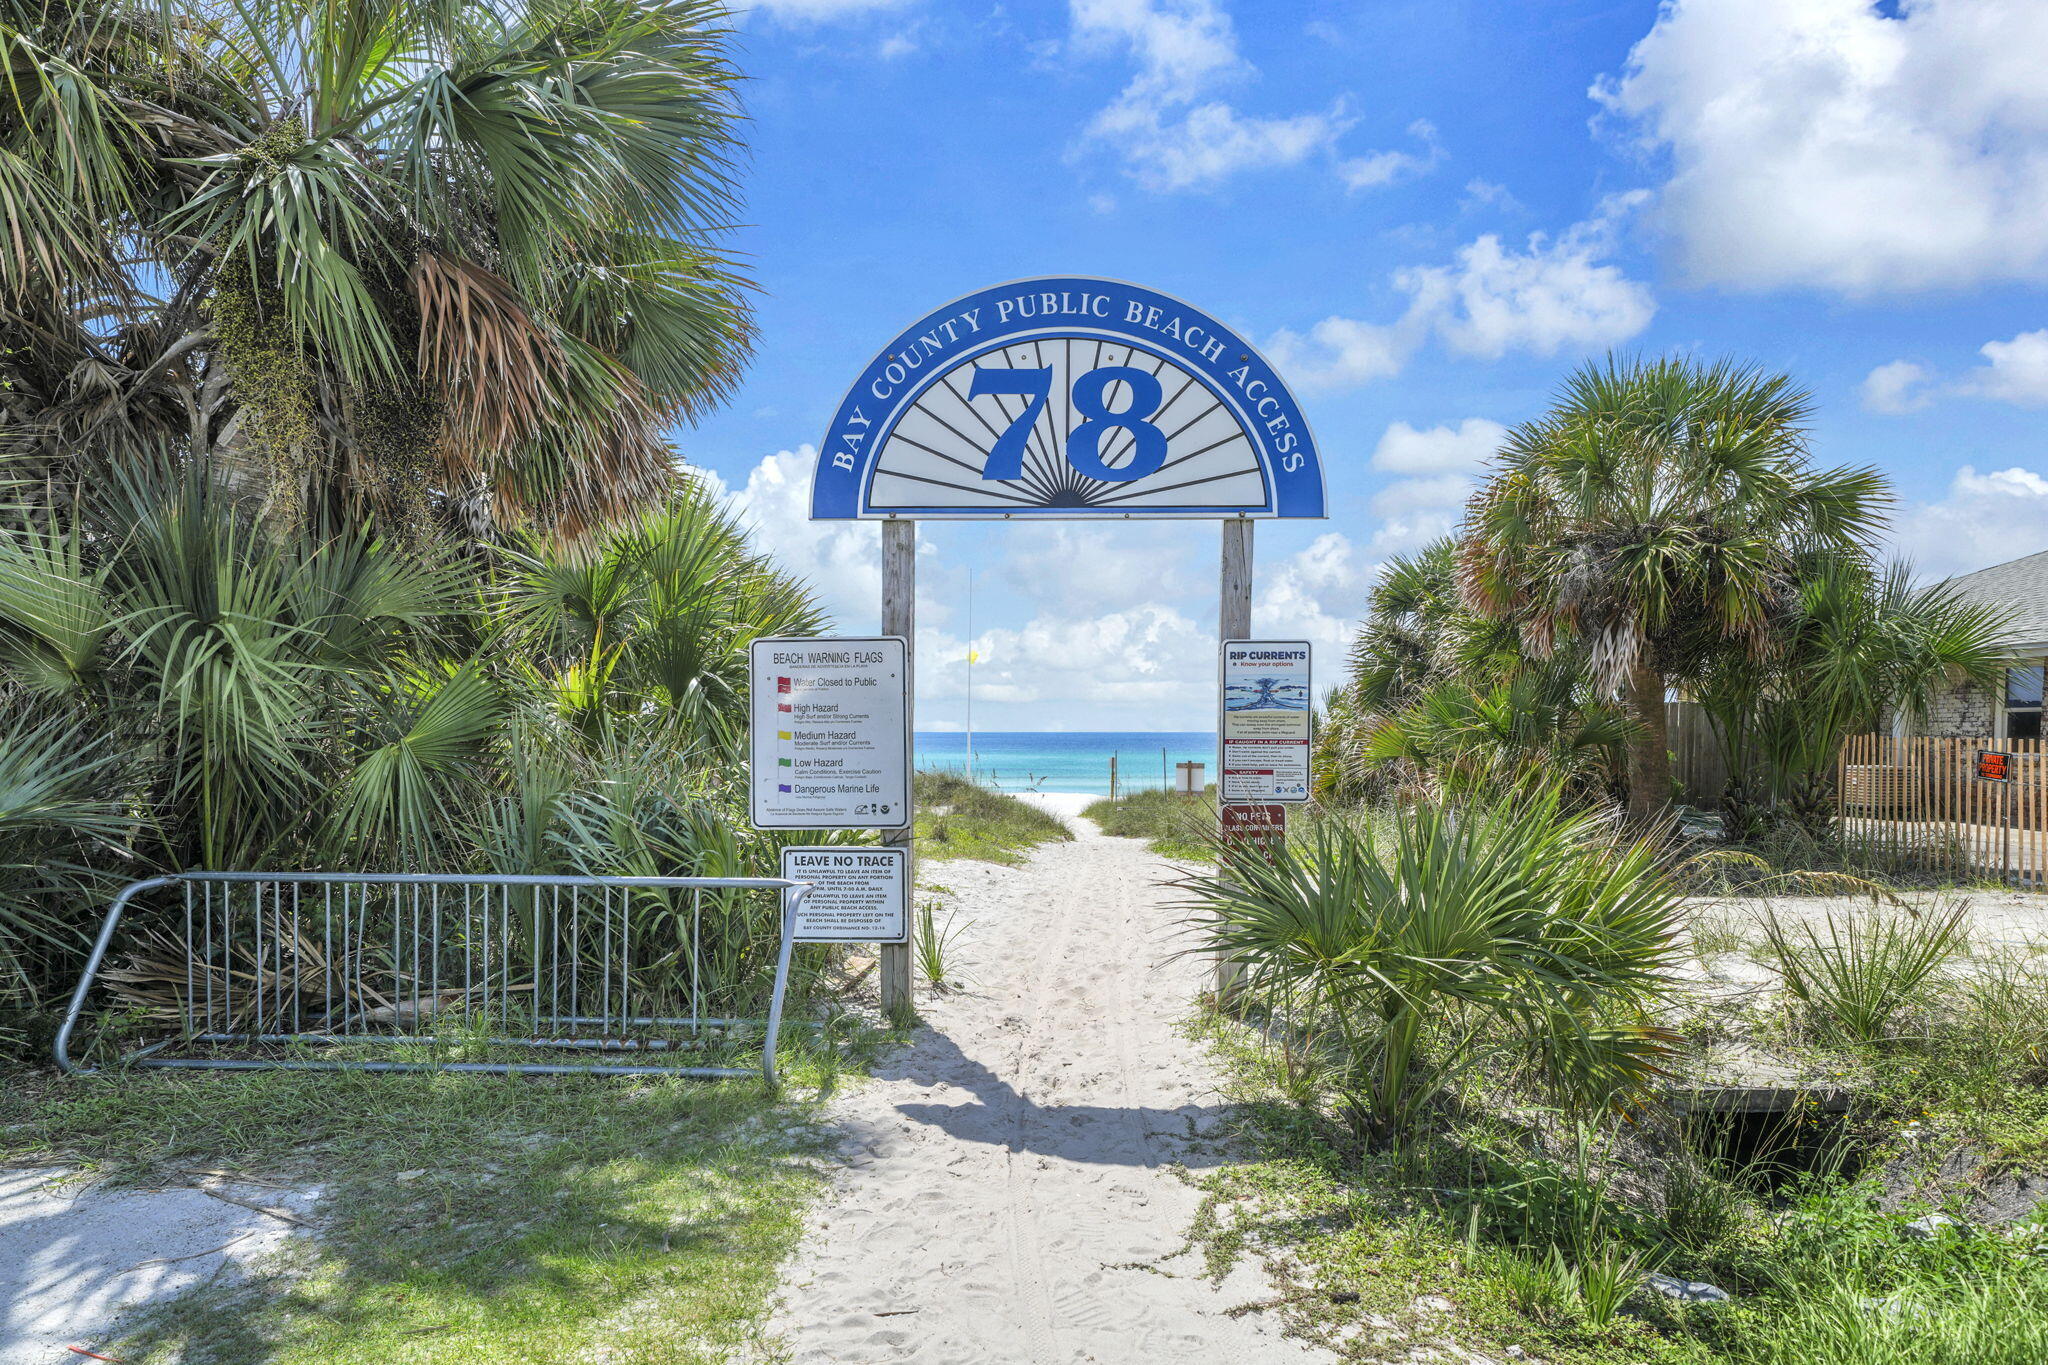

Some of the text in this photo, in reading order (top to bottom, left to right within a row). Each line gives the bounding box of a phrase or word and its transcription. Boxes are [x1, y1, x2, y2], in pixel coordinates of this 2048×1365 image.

[832, 292, 1307, 474] BAY COUNTY PUBLIC BEACH ACCESS
[967, 363, 1168, 482] 78
[774, 652, 883, 664] BEACH WARNING FLAGS
[1230, 652, 1305, 660] RIP CURRENTS
[794, 678, 877, 686] Water Closed to Public
[794, 704, 838, 714] High Hazard
[795, 731, 856, 740] Medium Hazard
[795, 758, 843, 767] Low Hazard
[1983, 754, 2004, 764] PRIVATE
[1979, 763, 2006, 774] PROPERTY
[795, 784, 879, 795] Dangerous Marine Life
[794, 856, 893, 866] LEAVE NO TRACE
